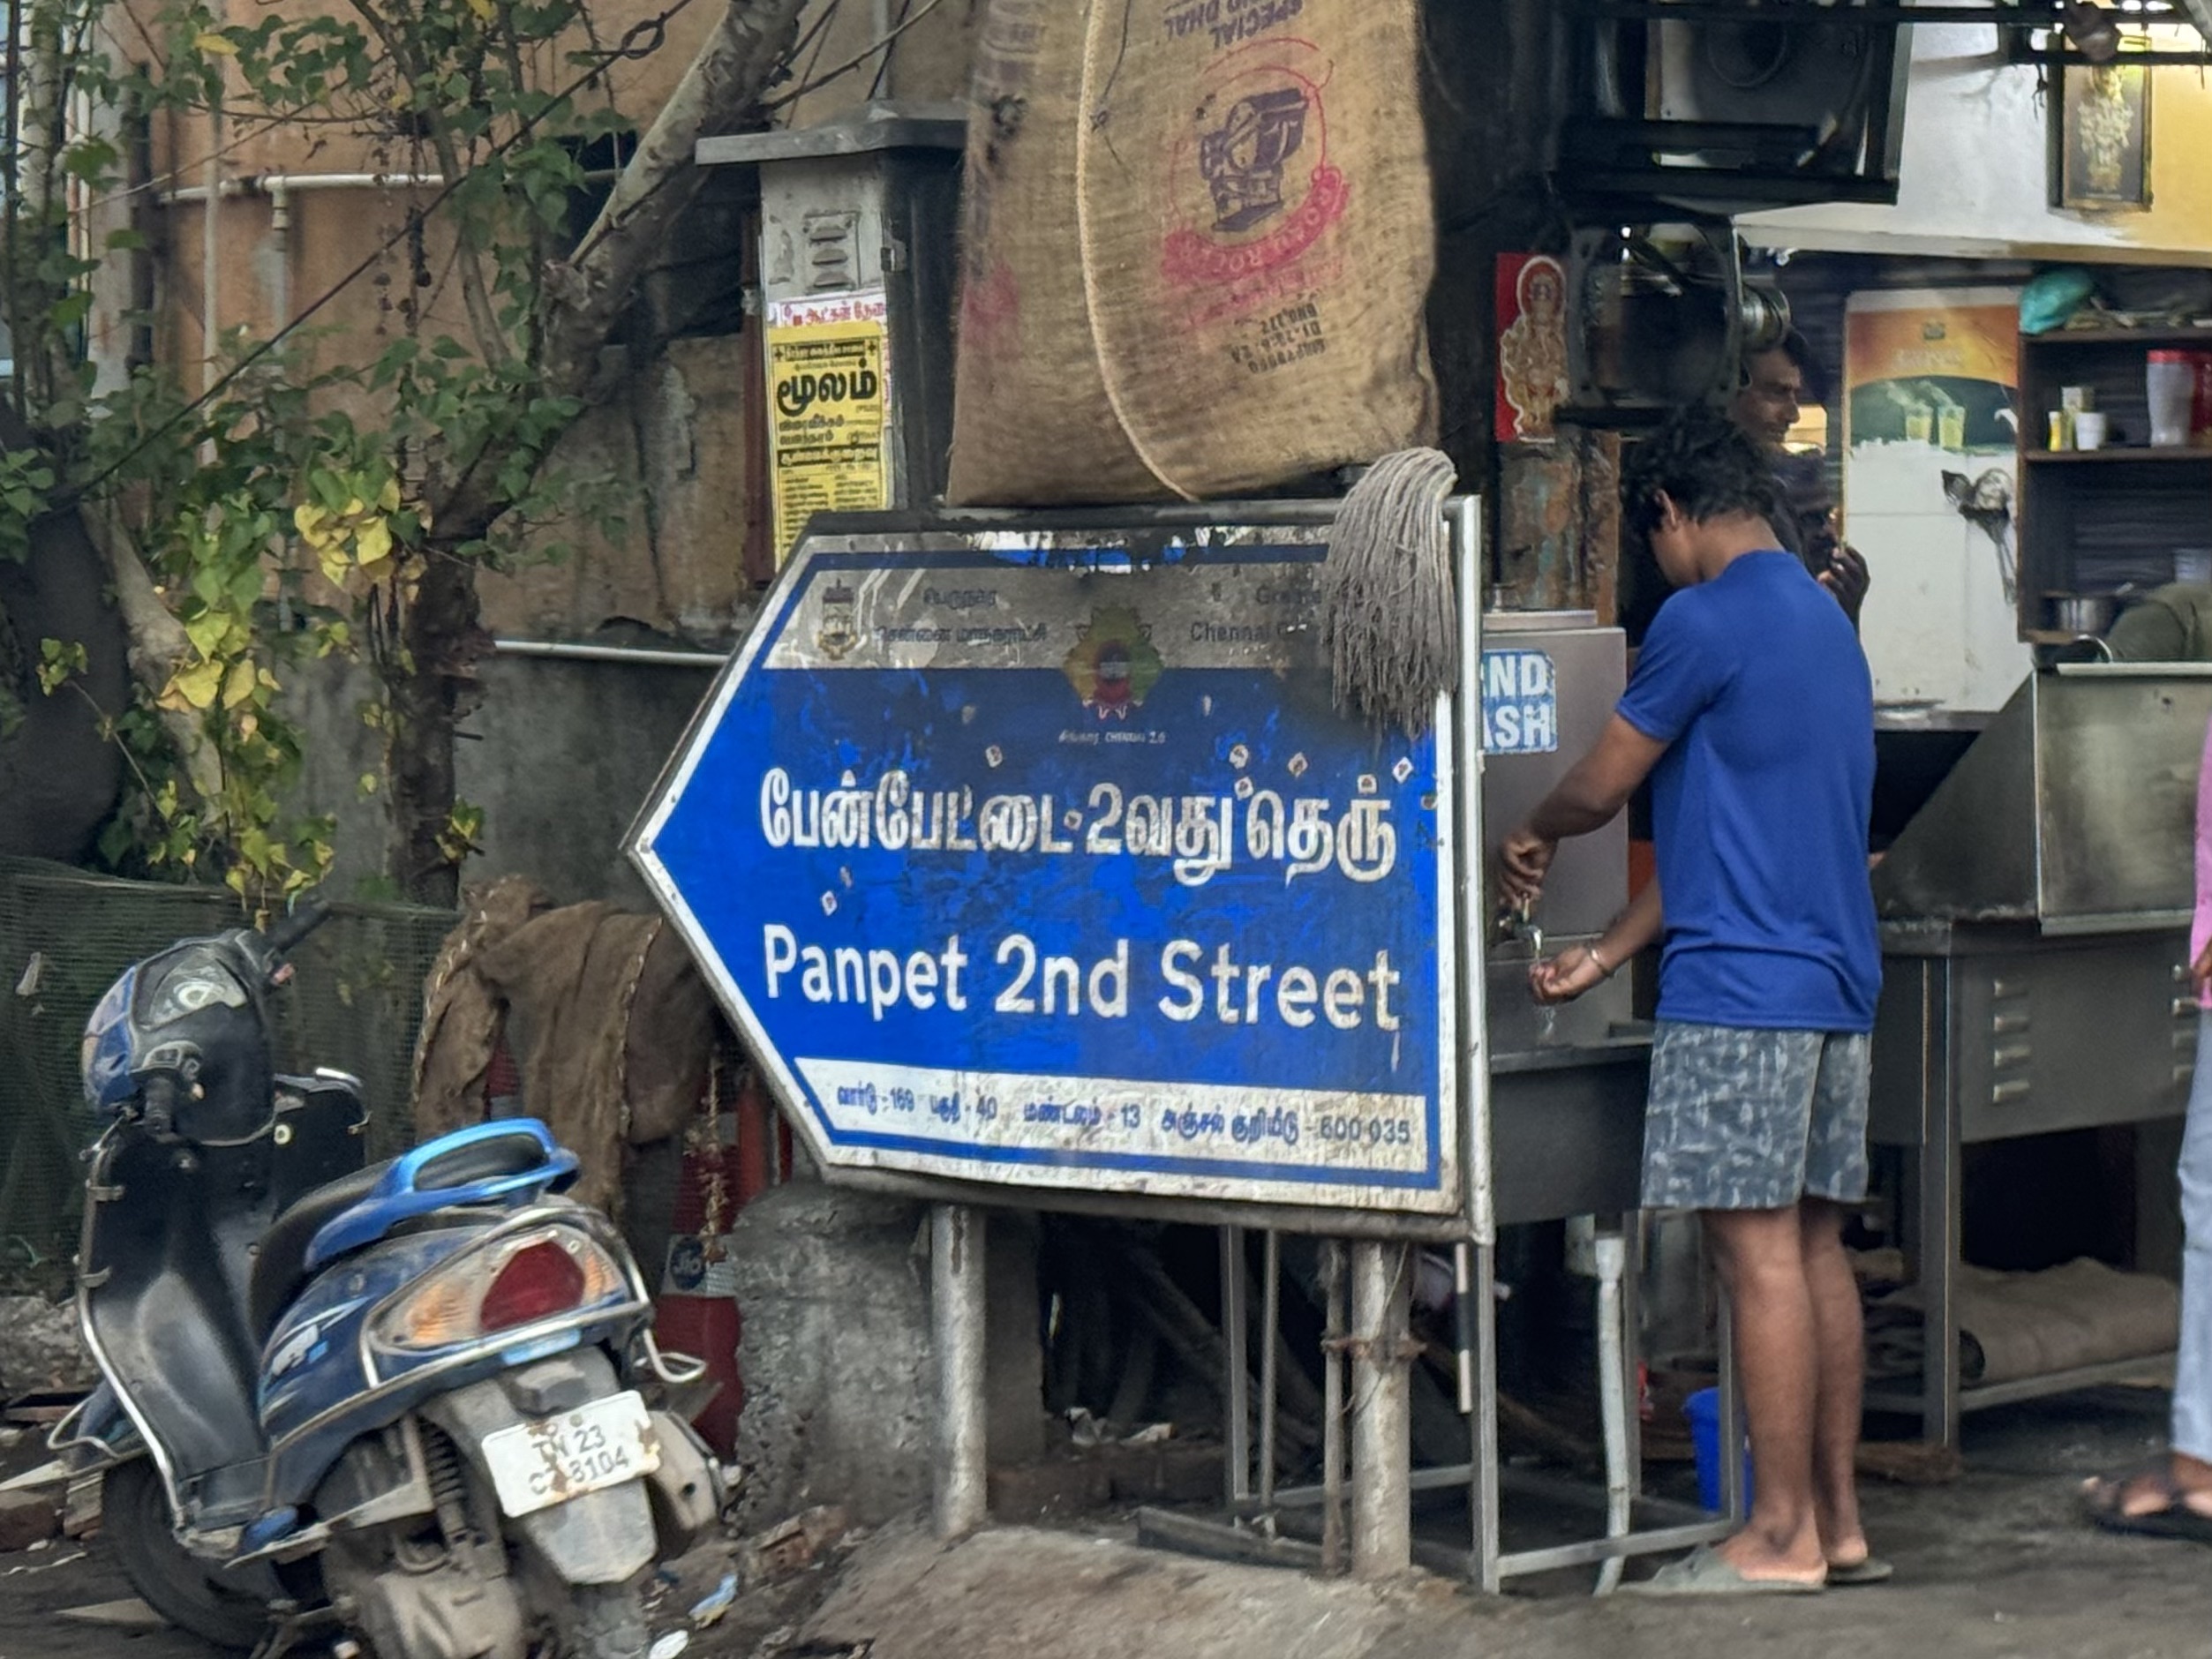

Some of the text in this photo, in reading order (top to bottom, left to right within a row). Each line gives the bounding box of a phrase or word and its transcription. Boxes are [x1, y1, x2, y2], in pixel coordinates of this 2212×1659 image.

[1164, 0, 1219, 41] DHAL
[1209, 0, 1303, 49] SPECIAL
[778, 357, 877, 417] மூலம்
[1191, 620, 1272, 642] Chennai
[1480, 654, 1548, 698] ND
[1085, 782, 1233, 885] 2வது
[1246, 788, 1397, 888] தெரு
[764, 924, 1400, 1030] Panpet 2nd Street
[890, 1088, 915, 1113] 169
[975, 1095, 998, 1120] 40
[1120, 1103, 1141, 1130] 13
[1160, 1104, 1225, 1139] அஞ்சல்
[1320, 1115, 1362, 1141] 600
[1368, 1116, 1411, 1145] 035
[531, 1423, 606, 1462] TN 23
